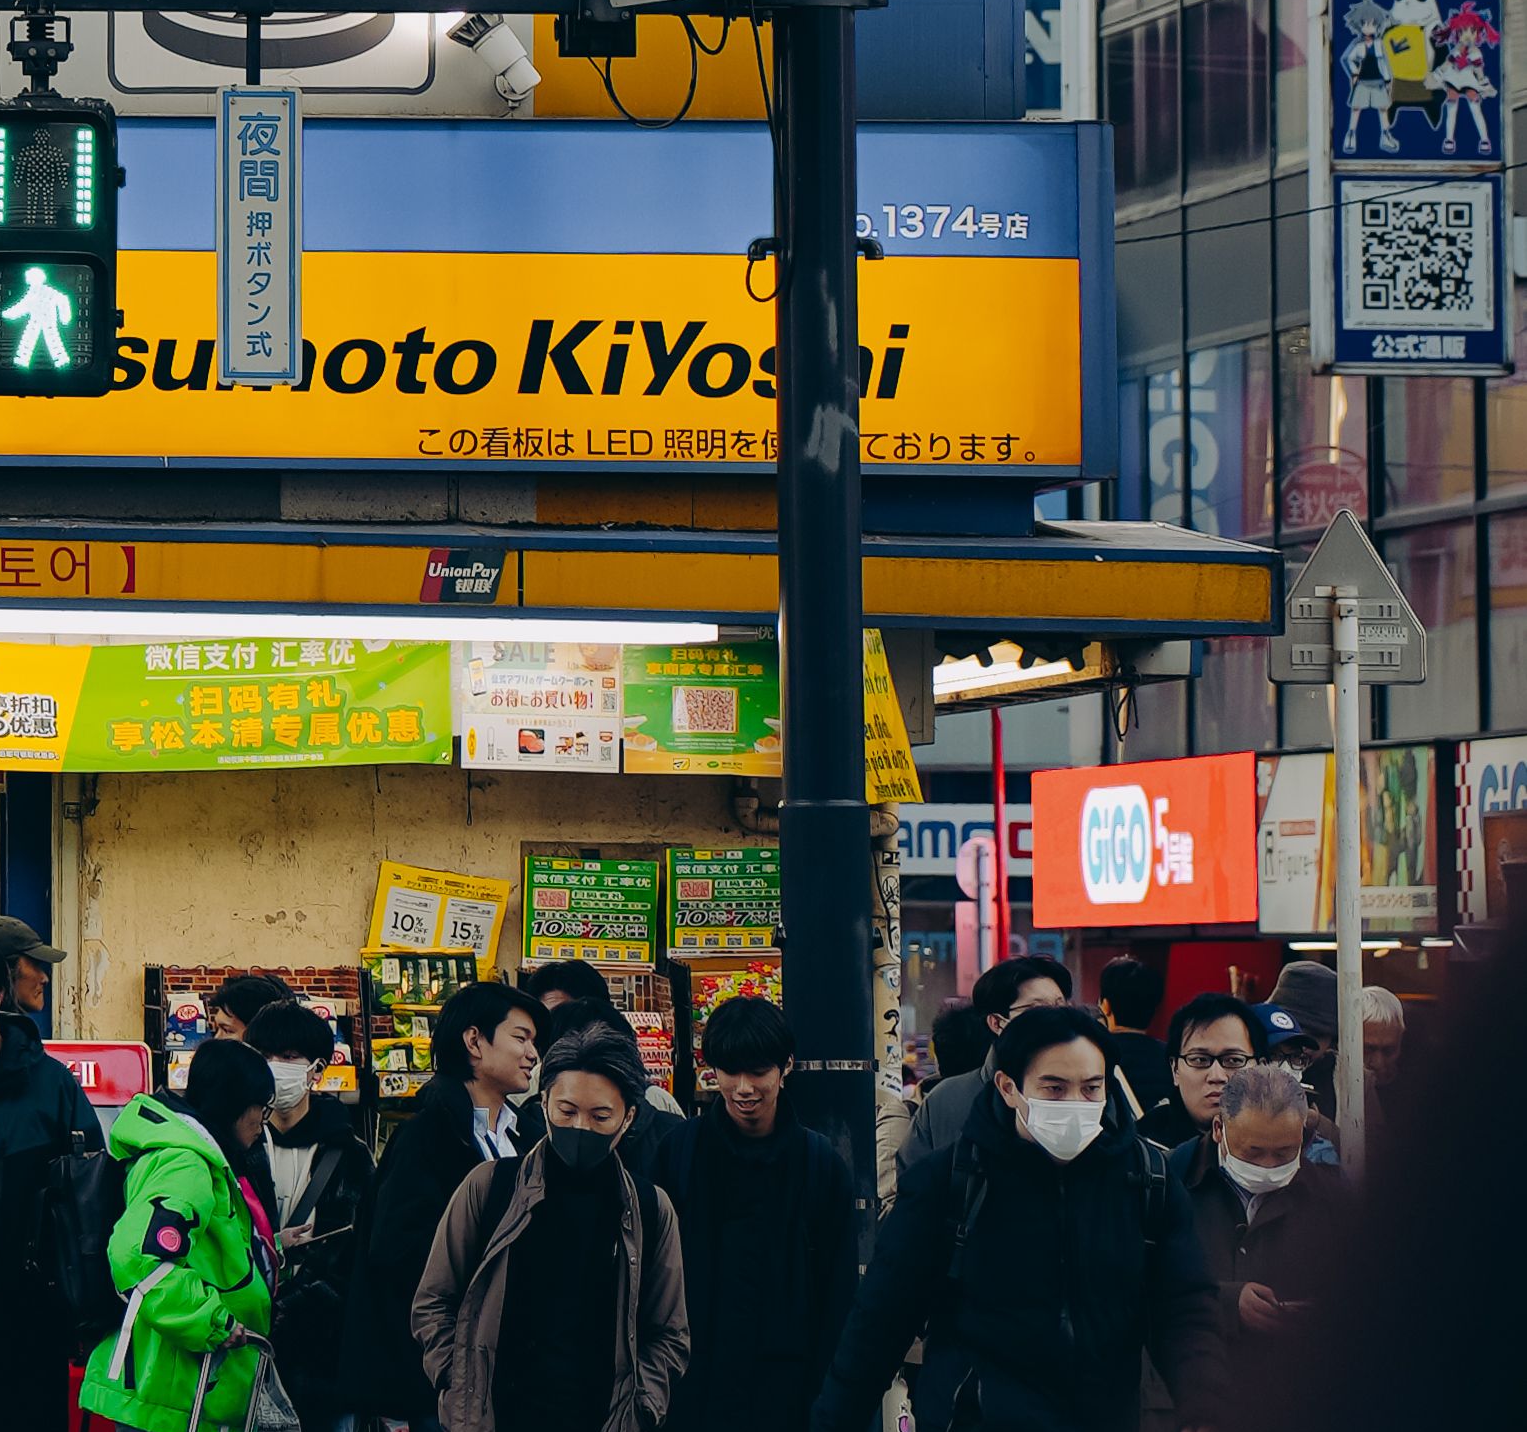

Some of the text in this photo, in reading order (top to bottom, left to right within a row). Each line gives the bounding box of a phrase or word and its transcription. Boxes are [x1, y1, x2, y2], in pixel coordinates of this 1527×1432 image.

[1371, 334, 1466, 359] 公式通販
[416, 429, 575, 460] この看板は
[587, 431, 654, 458] LED
[428, 562, 499, 583] UnionPay
[145, 640, 356, 672] 微信支付 汇率优
[189, 679, 341, 717] 扫码有礼
[111, 708, 420, 751] 享松本清专属优惠
[1087, 803, 1146, 885] GiGO
[746, 864, 780, 873] 汇率
